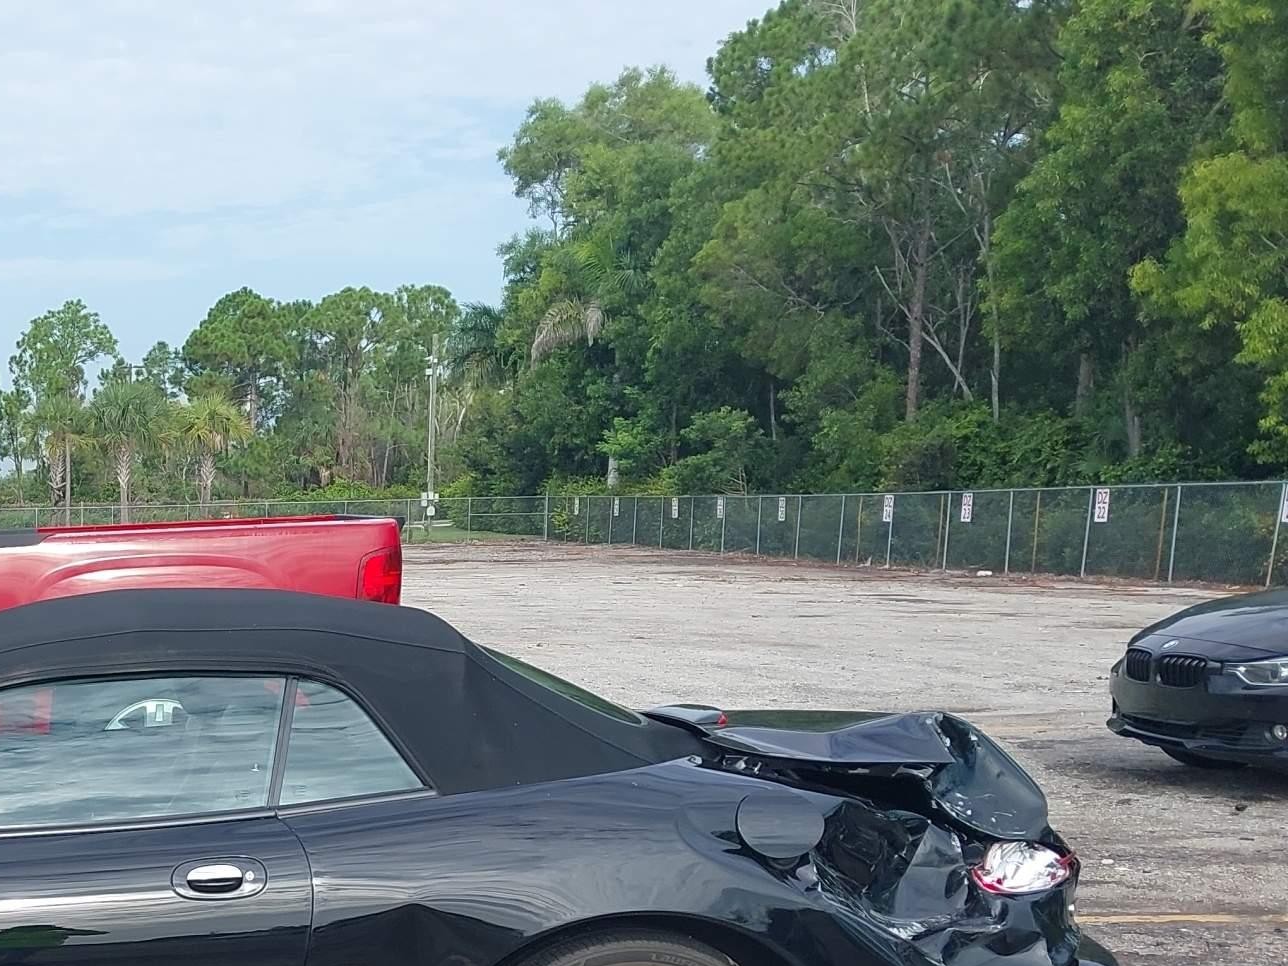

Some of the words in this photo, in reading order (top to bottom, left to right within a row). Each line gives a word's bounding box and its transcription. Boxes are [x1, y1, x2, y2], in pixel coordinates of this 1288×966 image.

[963, 495, 972, 506] DZ
[1097, 491, 1108, 504] DZ
[1096, 506, 1106, 519] 22
